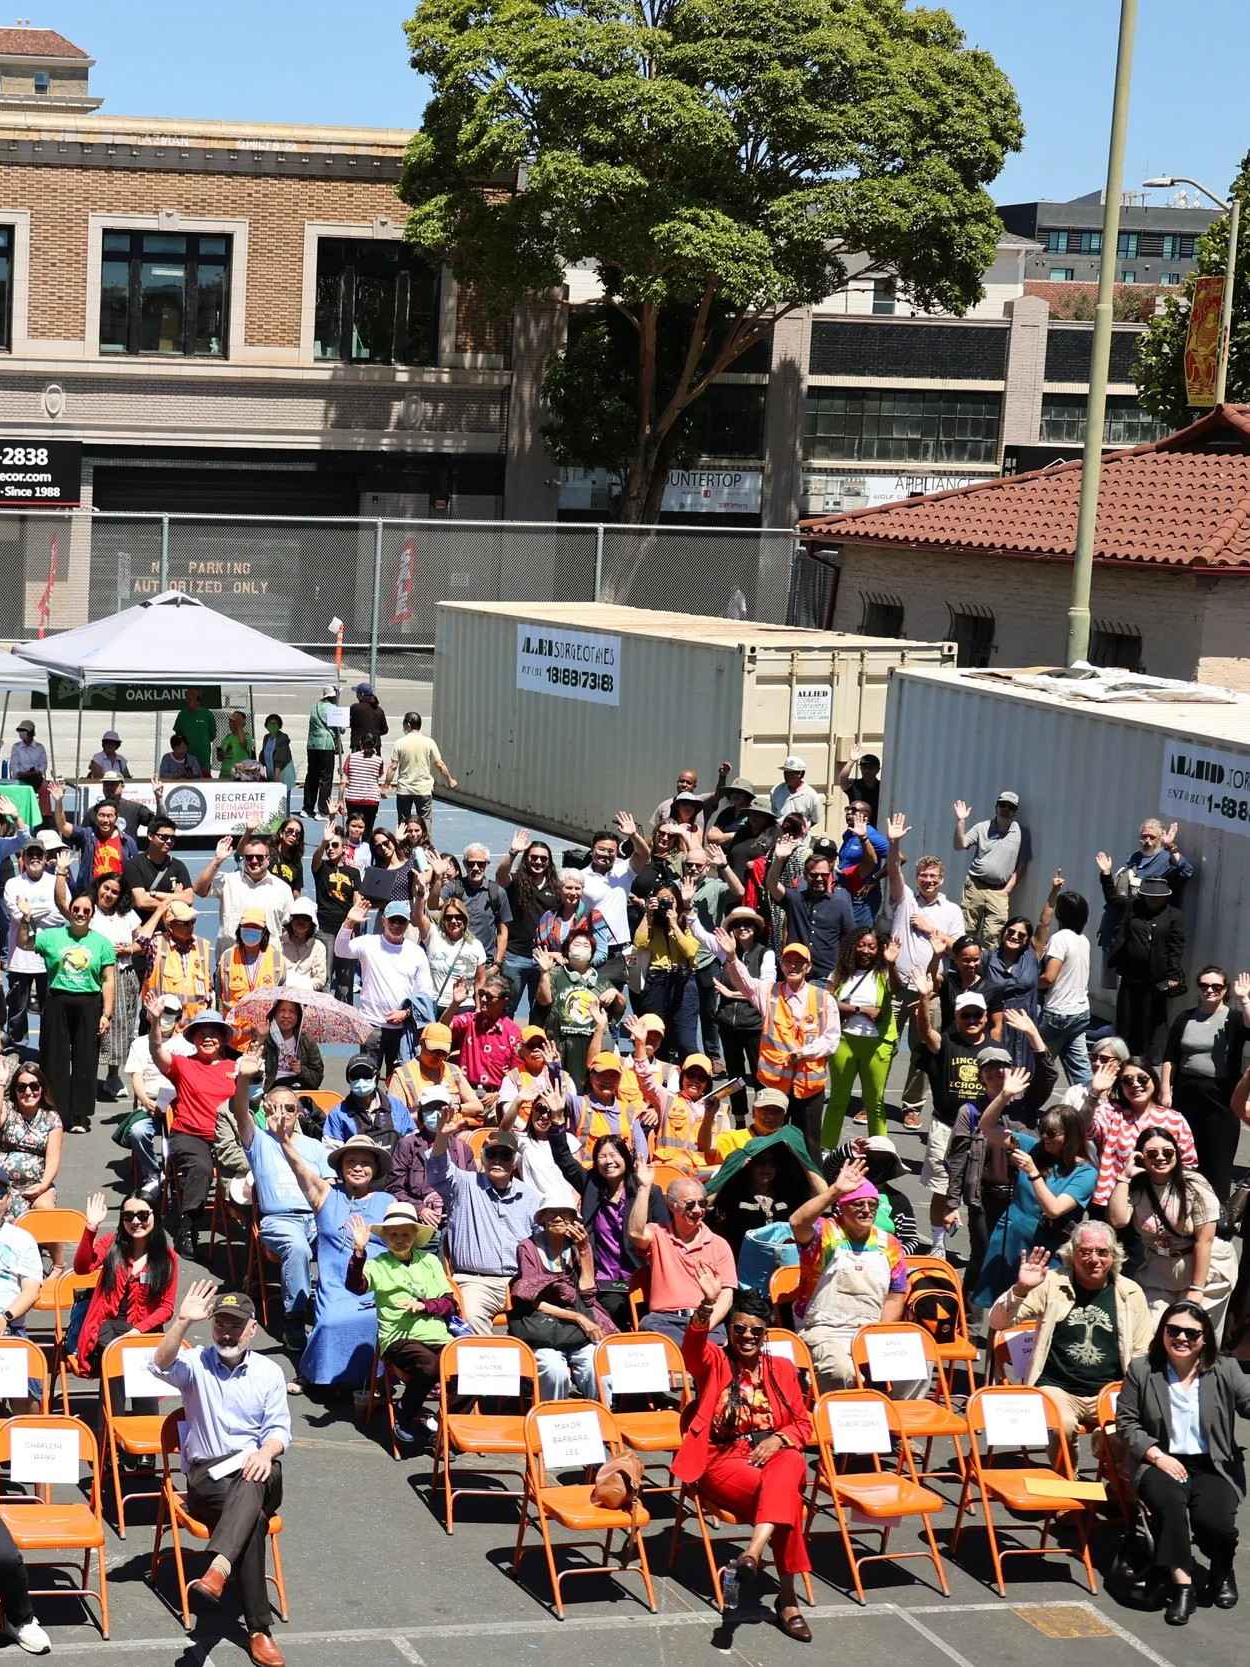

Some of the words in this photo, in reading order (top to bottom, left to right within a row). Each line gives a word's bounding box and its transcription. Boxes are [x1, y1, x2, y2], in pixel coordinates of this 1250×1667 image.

[666, 472, 742, 487] UNTERTOP
[35, 486, 61, 497] 1988
[189, 562, 251, 574] PARKING
[134, 581, 223, 593] AUTORIZED
[233, 582, 269, 594] ONLY
[215, 792, 266, 802] RECREATE
[215, 802, 266, 811] REIMAGINE
[951, 1057, 978, 1066] LINCO
[949, 1081, 986, 1091] SCHOO
[554, 1421, 582, 1429] MAYOR
[552, 1434, 588, 1443] BARBARA
[565, 1448, 579, 1456] LEE
